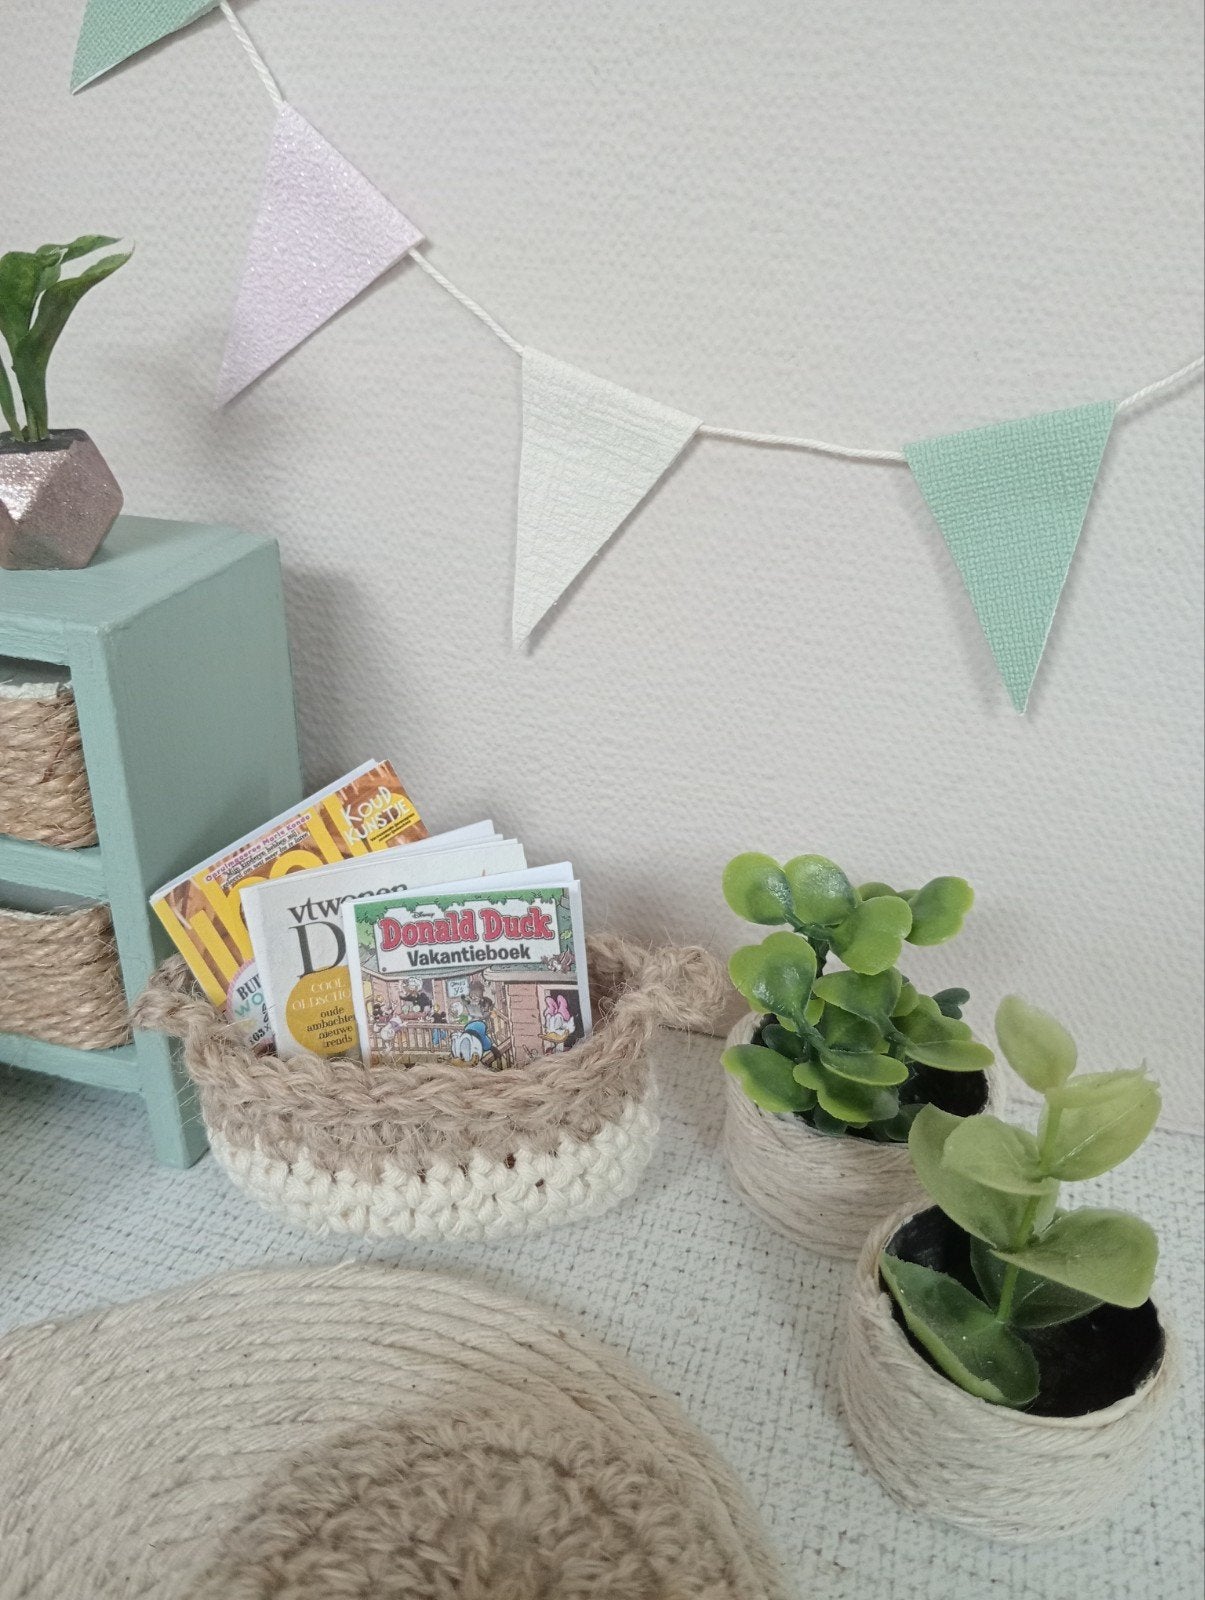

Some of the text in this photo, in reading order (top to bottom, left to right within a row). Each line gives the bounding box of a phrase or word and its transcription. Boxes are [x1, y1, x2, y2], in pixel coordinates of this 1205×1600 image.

[342, 786, 392, 827] KOUD
[262, 828, 286, 846] Marie
[286, 814, 311, 831] Kondo
[345, 799, 410, 845] KUNSTJE
[379, 906, 554, 951] Donald Duck
[407, 944, 531, 967] Vakantieboek
[311, 978, 344, 992] COOL
[320, 1006, 344, 1018] oude
[318, 1025, 352, 1040] nieuwe
